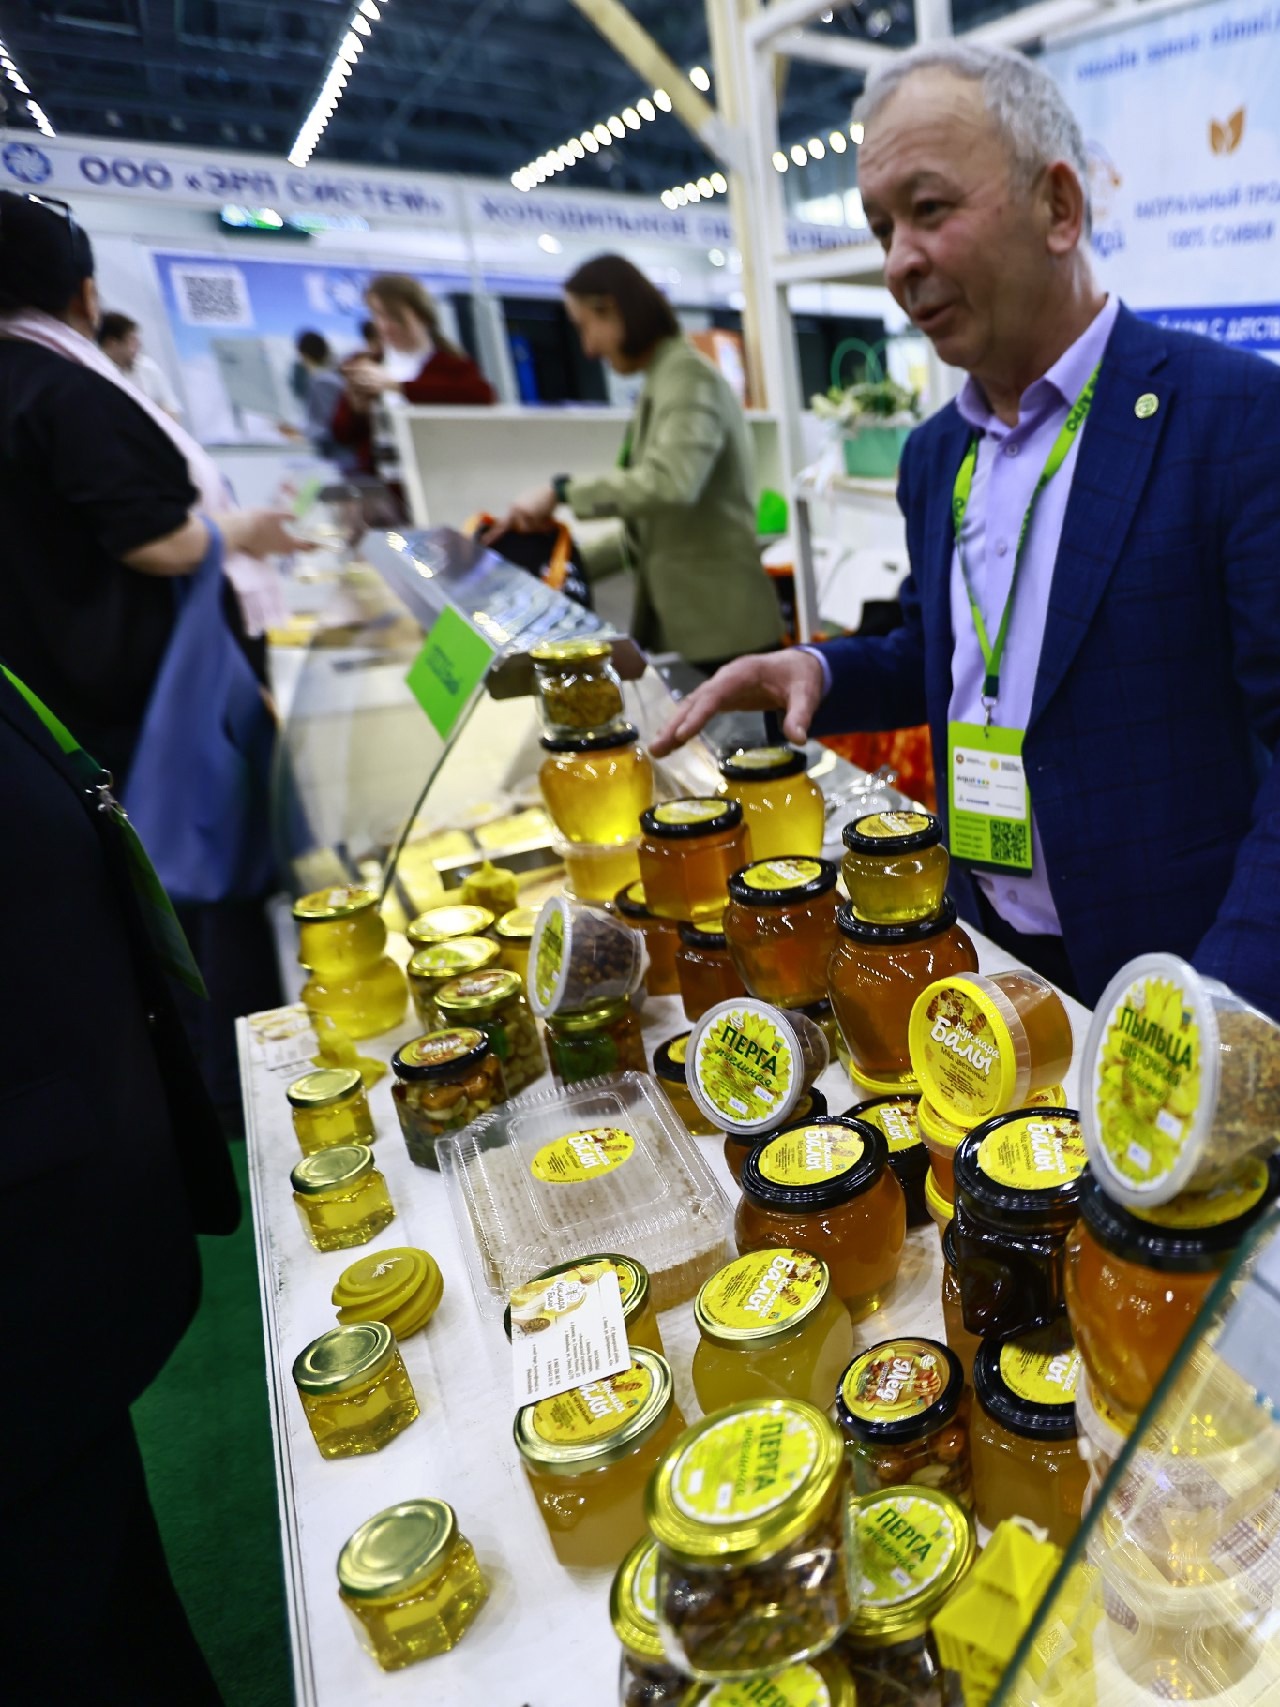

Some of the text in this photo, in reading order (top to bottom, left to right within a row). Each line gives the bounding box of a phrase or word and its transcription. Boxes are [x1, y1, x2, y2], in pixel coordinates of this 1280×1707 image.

[80, 156, 172, 189] ООО
[720, 1025, 777, 1077] ПЕРГА
[931, 1015, 992, 1075] Балы
[956, 1022, 1000, 1058] Кукмара
[1120, 1007, 1192, 1072] ПЫЛЬЦА
[567, 1134, 600, 1169] Балы
[804, 1130, 828, 1171] Балы
[1027, 1123, 1056, 1172] Балы
[743, 1255, 796, 1311] Балы
[753, 1421, 783, 1494] ПЕРГА
[876, 1507, 932, 1563] ПЕРГА
